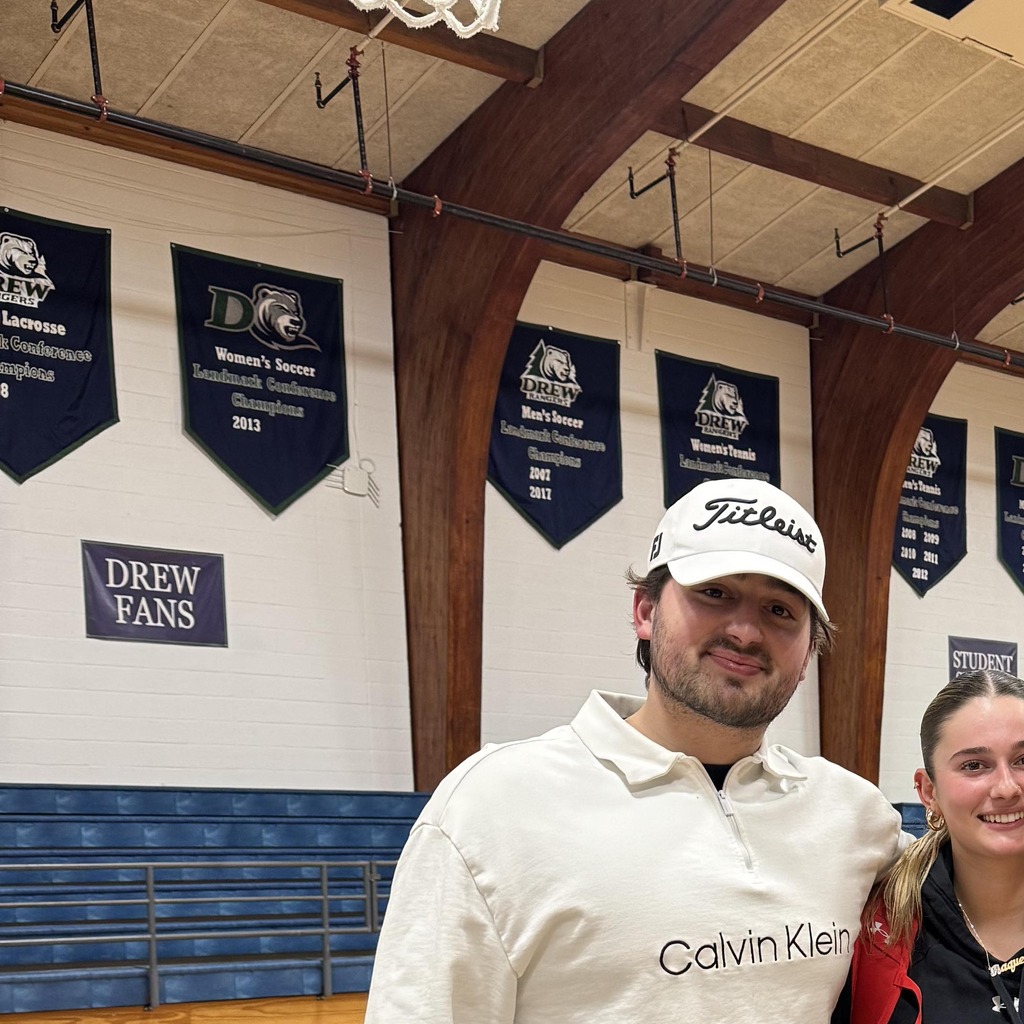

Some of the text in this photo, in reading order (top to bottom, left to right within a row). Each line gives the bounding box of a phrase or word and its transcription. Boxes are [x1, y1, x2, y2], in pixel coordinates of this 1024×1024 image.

[2, 310, 66, 336] Lacrosse
[10, 336, 92, 361] Conference
[215, 346, 316, 377] Women's Soccer
[192, 363, 337, 402] Landmark Conference
[521, 378, 579, 400] DREW
[231, 392, 305, 418] Champions
[529, 392, 568, 406] RANGERS
[232, 415, 261, 432] 2013
[521, 405, 584, 429] Men's Soccer
[698, 412, 746, 433] DREW
[690, 438, 756, 461] Women's Tennis
[910, 457, 938, 471] REW
[529, 485, 552, 500] 2017
[918, 480, 941, 495] Tennis
[693, 497, 817, 553] Titleist
[923, 550, 939, 565] 2011
[105, 558, 201, 595] DREW
[114, 594, 195, 629] FANS
[953, 650, 1013, 673] STUDENT
[659, 921, 851, 975] Calvin Klein
